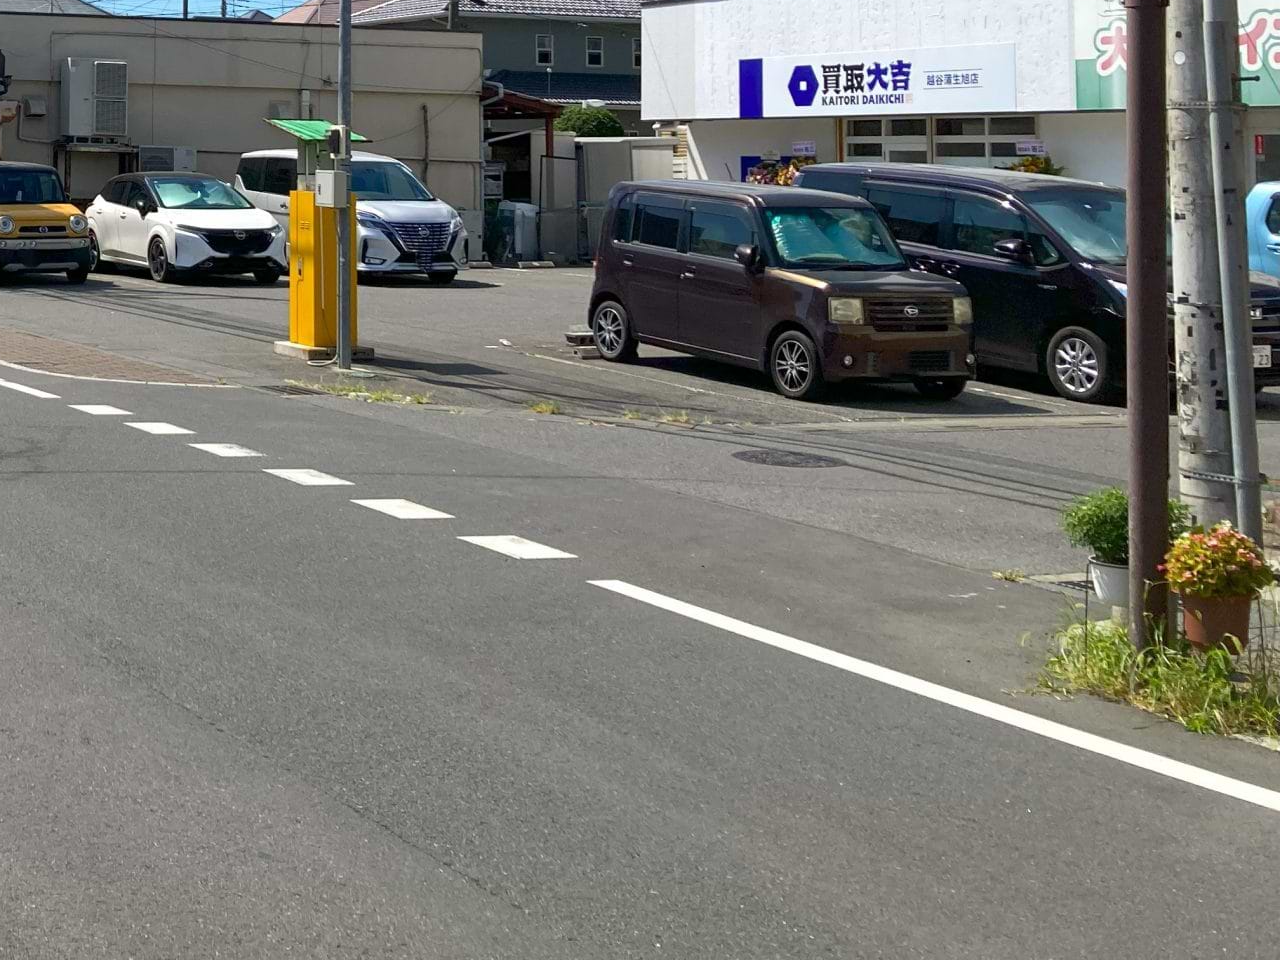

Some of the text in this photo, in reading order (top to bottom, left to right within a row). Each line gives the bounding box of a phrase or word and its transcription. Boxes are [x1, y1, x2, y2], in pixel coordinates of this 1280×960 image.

[821, 60, 912, 94] 買取大吉
[821, 95, 859, 106] KAITORI
[862, 94, 904, 105] DAIKICHI
